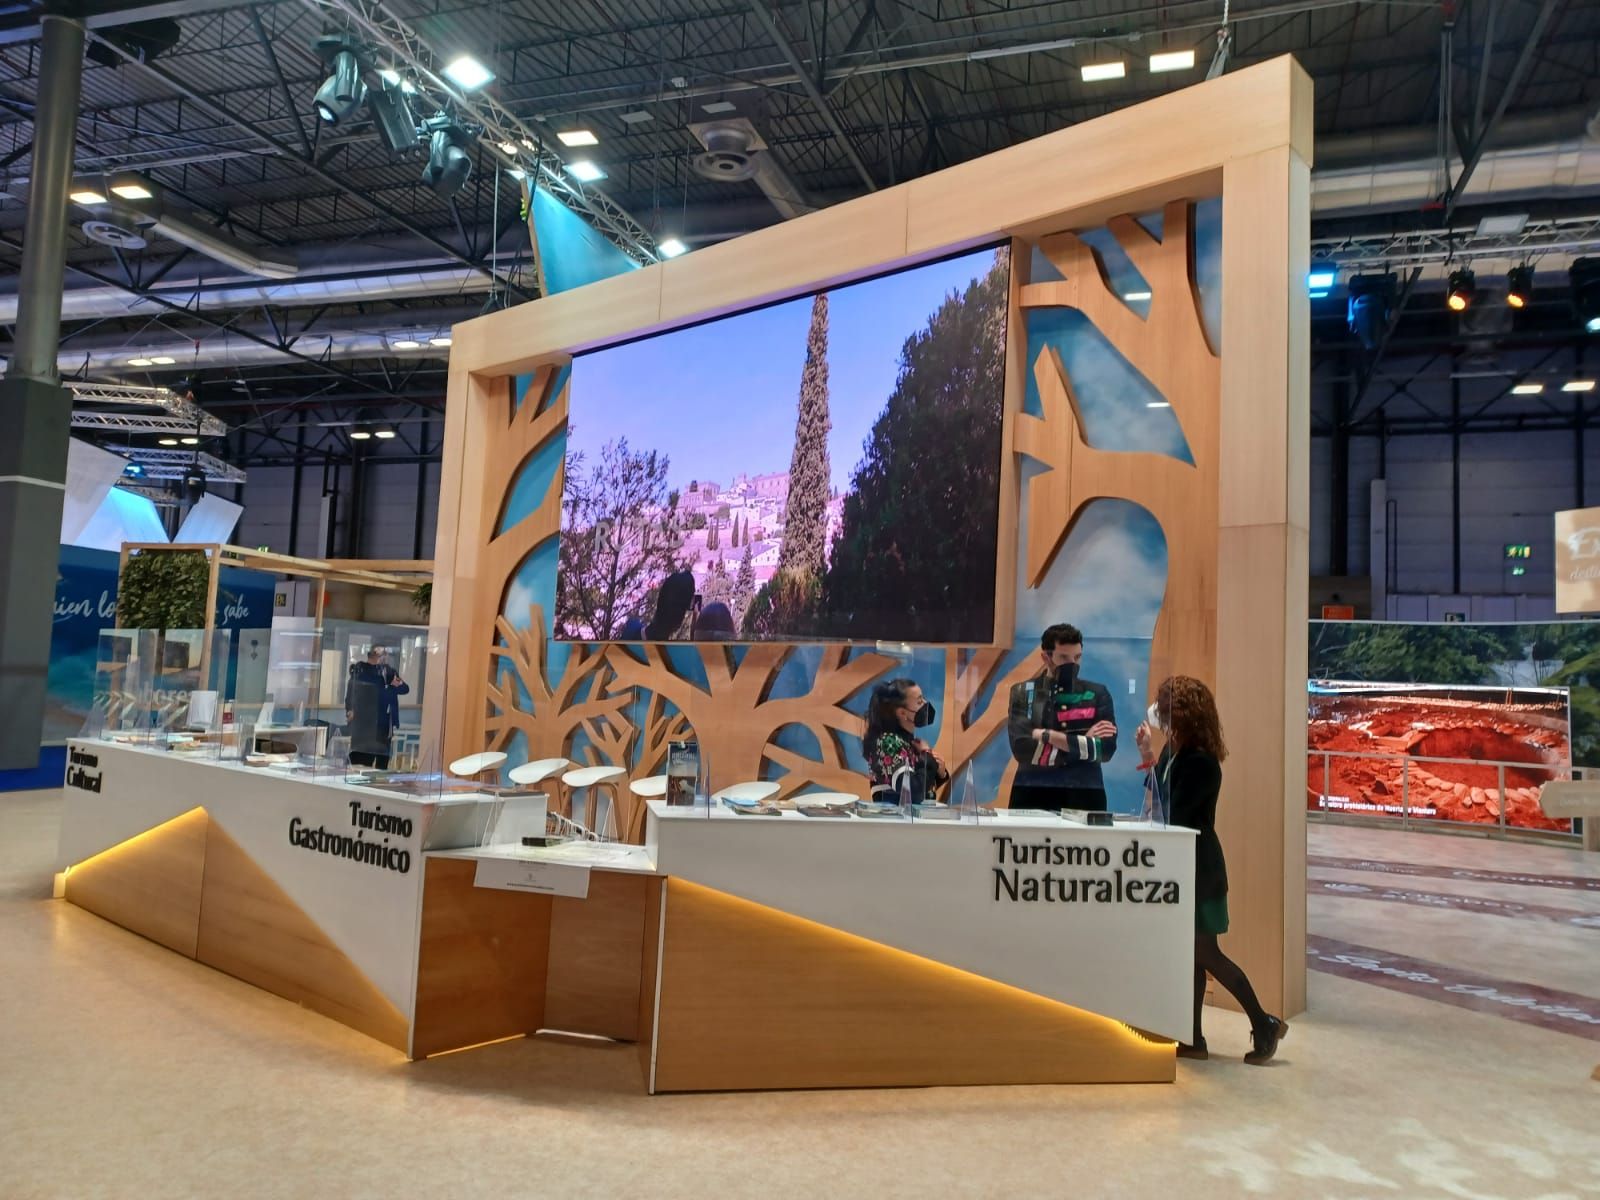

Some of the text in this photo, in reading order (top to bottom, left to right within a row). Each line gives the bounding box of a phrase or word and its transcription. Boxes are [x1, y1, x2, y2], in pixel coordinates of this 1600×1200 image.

[349, 801, 413, 838] Turismo
[289, 817, 411, 874] Gastronómico
[992, 836, 1156, 867] Turismo de
[992, 868, 1180, 904] Naturaleza
